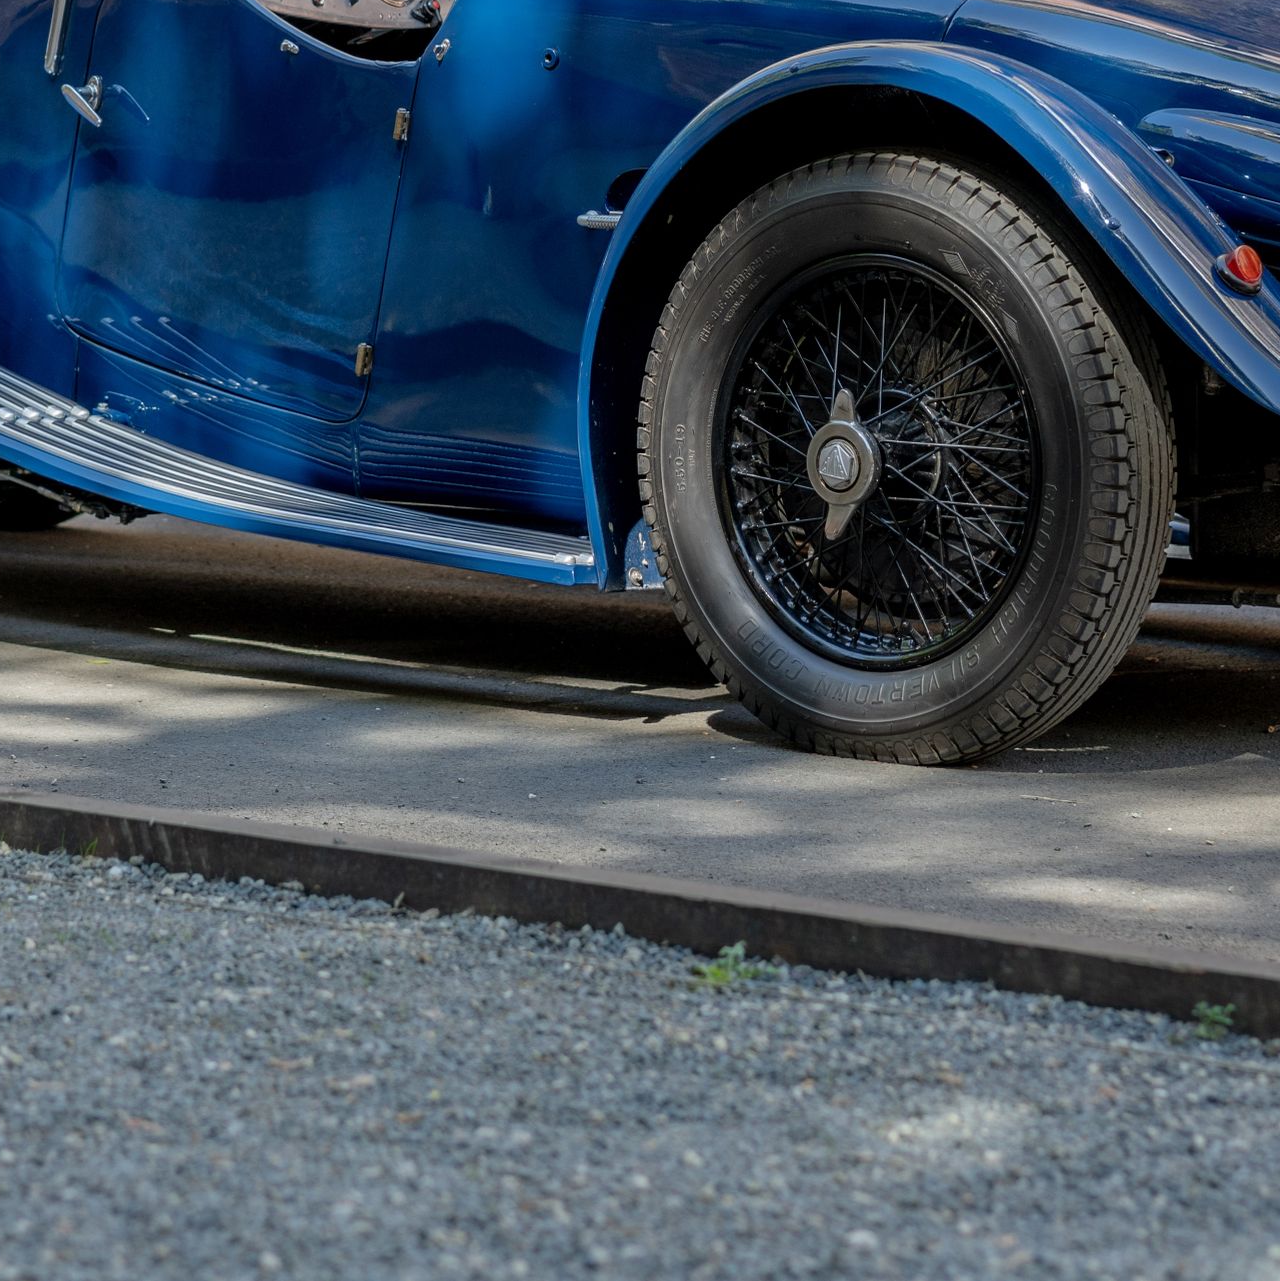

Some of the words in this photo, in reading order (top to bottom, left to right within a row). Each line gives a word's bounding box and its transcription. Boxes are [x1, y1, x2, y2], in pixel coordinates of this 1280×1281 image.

[991, 483, 1058, 647] GOODRICH
[737, 617, 809, 681] CORD
[814, 645, 981, 705] SILVERTOWN
